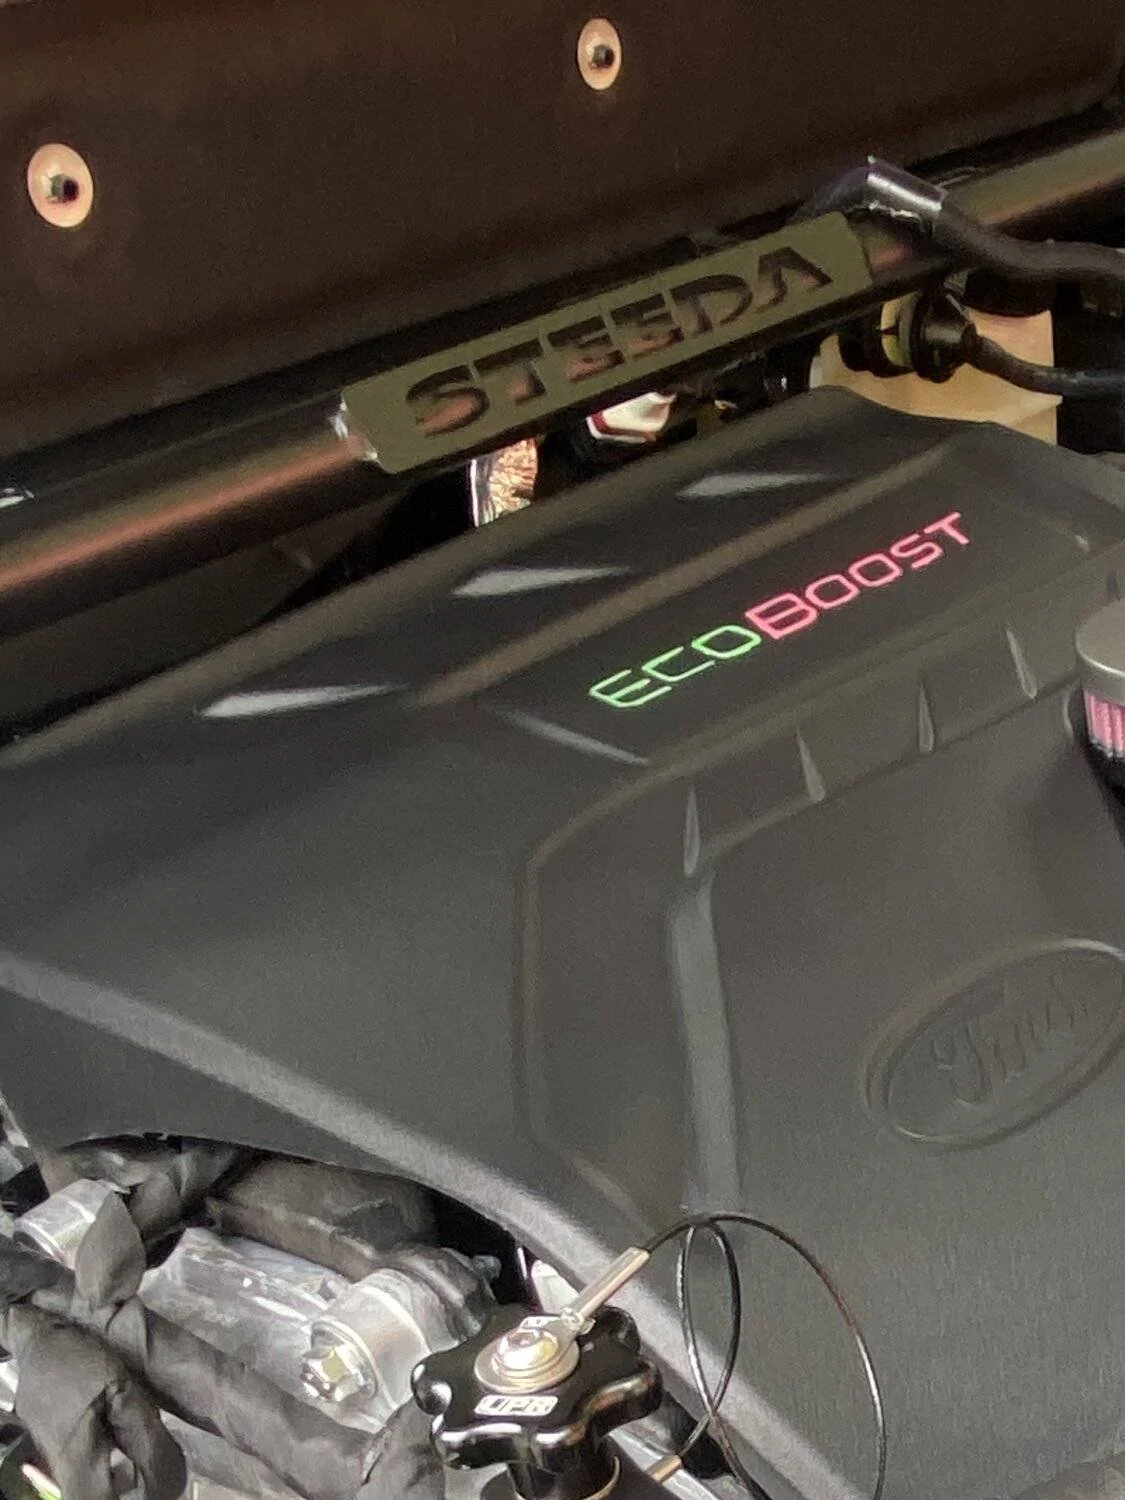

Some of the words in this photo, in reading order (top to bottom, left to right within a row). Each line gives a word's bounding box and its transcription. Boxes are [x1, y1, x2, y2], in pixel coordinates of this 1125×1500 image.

[405, 246, 832, 438] STEEDA
[588, 511, 971, 708] ECOBOOST
[475, 1395, 558, 1416] UPR
